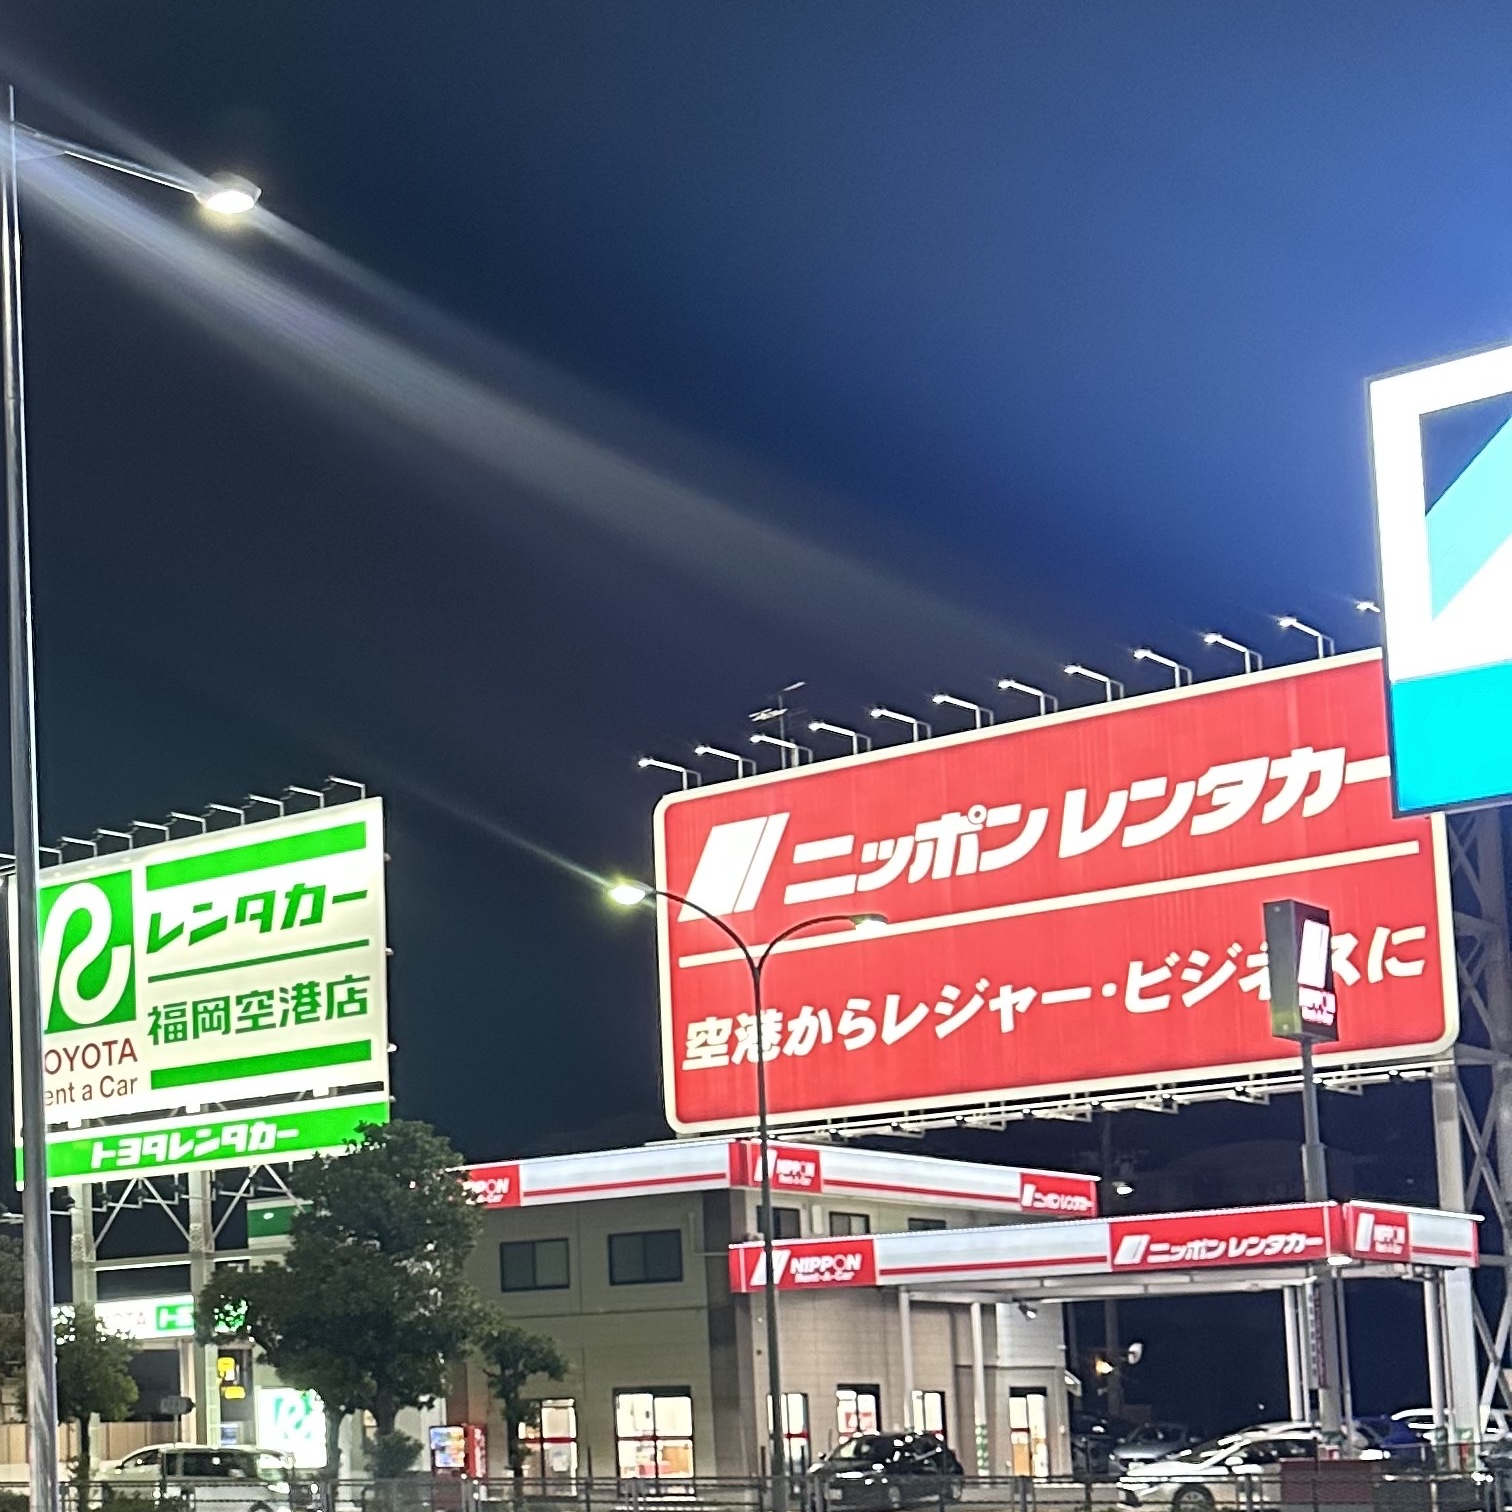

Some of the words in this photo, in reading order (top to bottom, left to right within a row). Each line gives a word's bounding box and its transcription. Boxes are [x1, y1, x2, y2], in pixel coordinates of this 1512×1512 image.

[147, 882, 369, 955] レンタカー
[147, 974, 371, 1046] 福岡空港店
[44, 1037, 139, 1075] OYOTA
[44, 1082, 75, 1106] ent
[82, 1084, 93, 1101] a
[99, 1075, 139, 1099] Car
[91, 1121, 300, 1169] トヨタレンタカー
[790, 1253, 862, 1274] NIPPON
